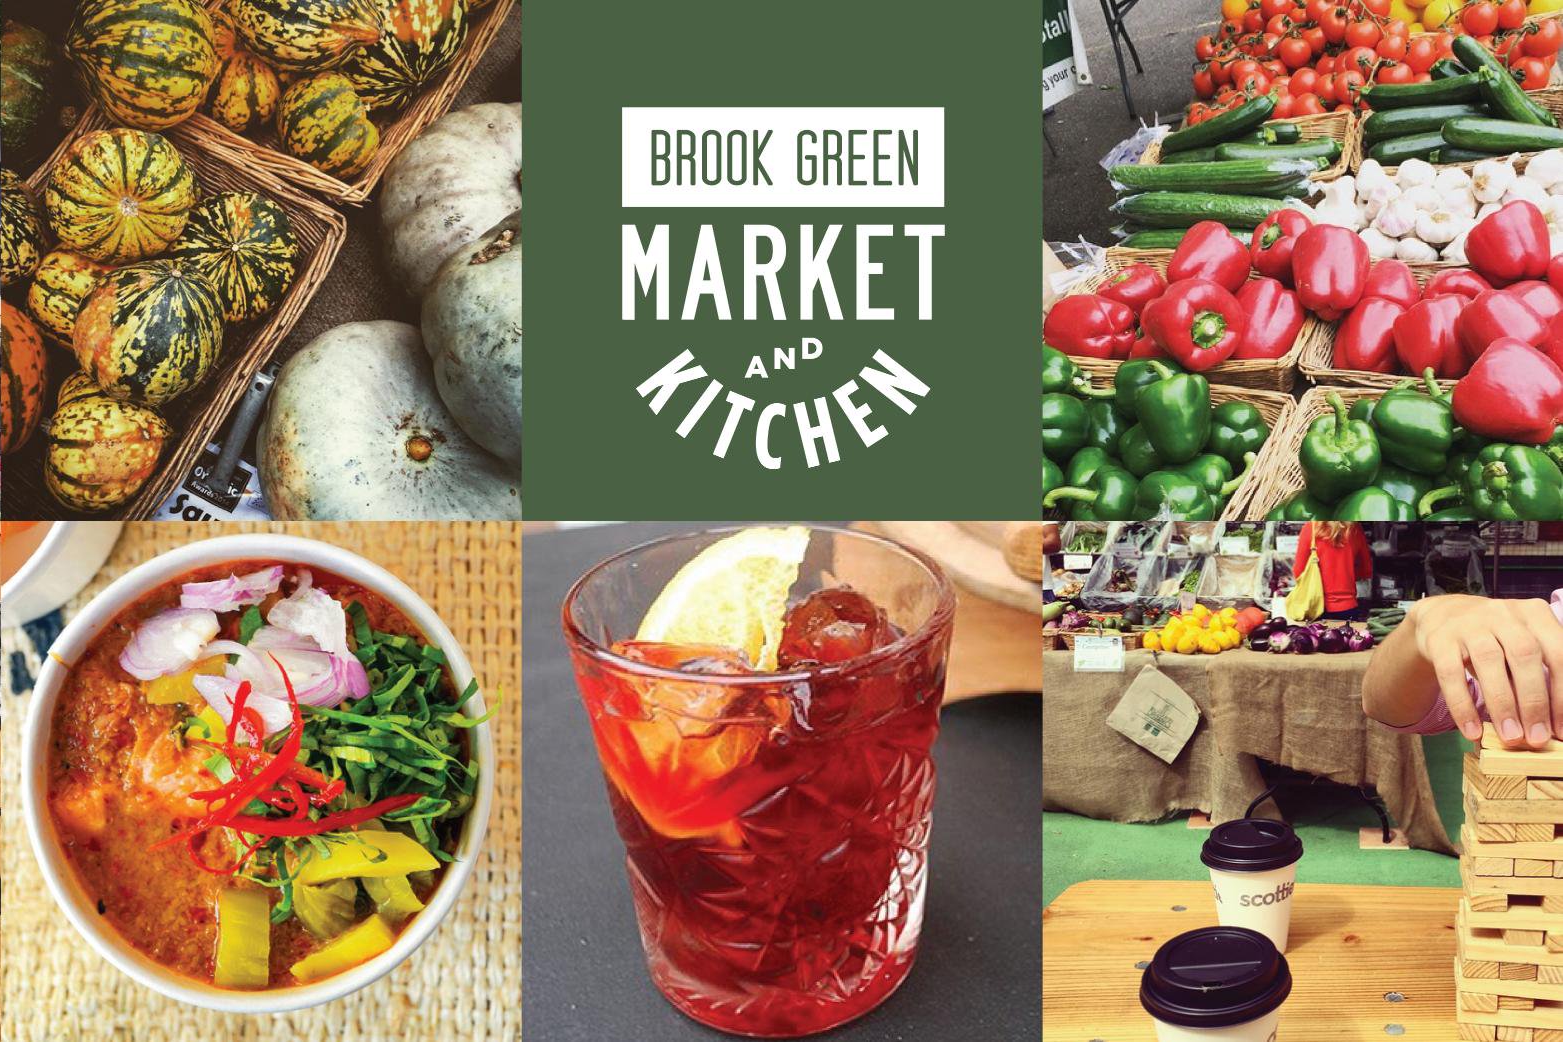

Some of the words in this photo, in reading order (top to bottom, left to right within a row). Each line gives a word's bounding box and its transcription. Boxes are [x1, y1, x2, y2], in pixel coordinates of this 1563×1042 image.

[1047, 68, 1069, 88] your
[191, 480, 215, 499] Awards
[194, 466, 238, 497] Oric
